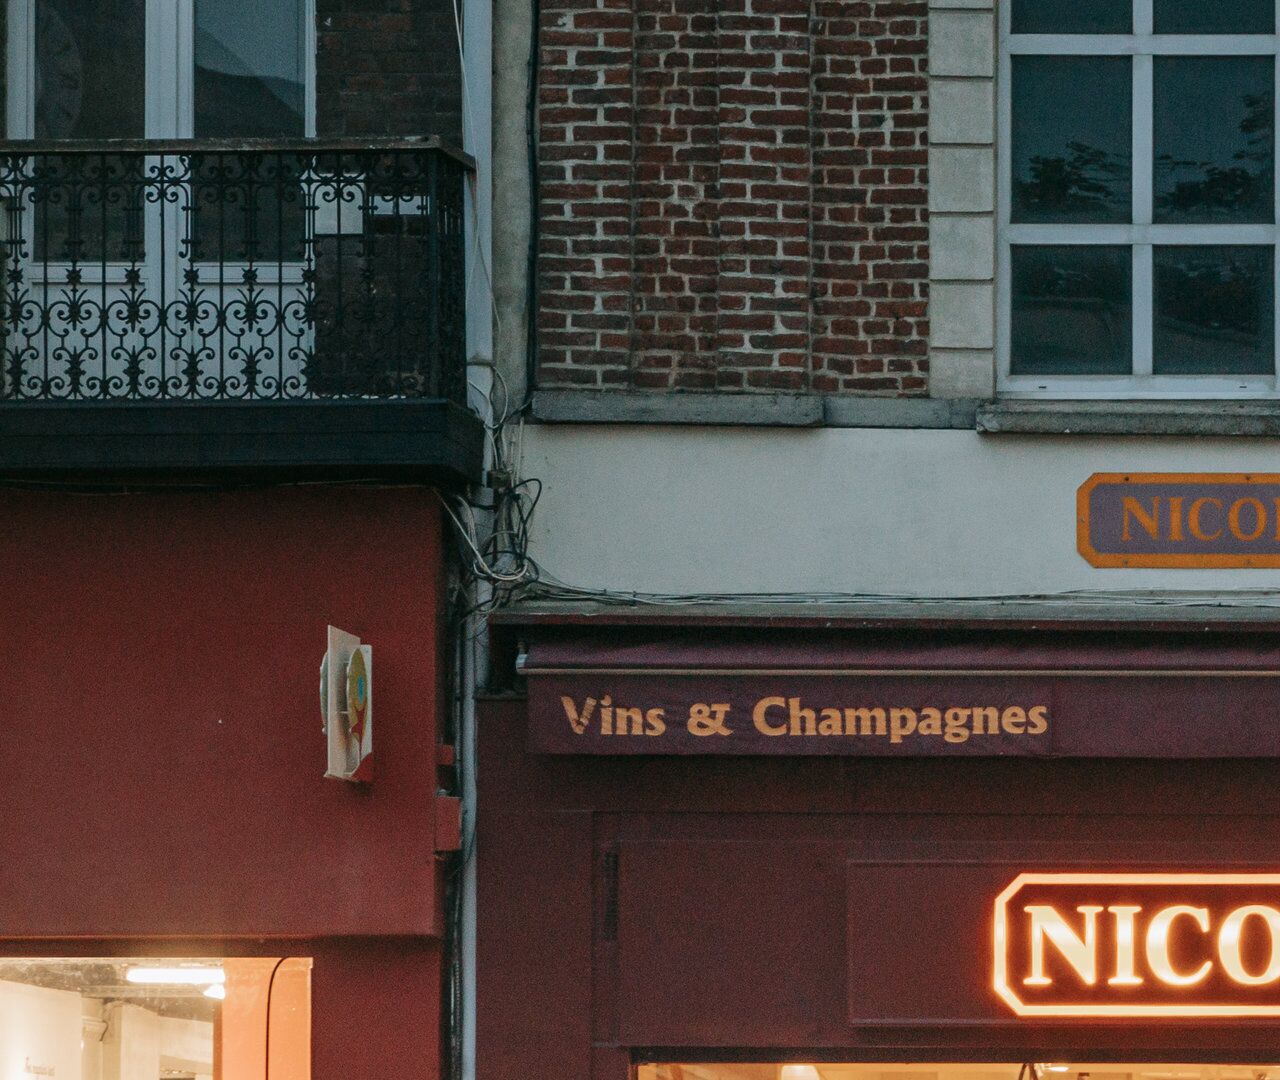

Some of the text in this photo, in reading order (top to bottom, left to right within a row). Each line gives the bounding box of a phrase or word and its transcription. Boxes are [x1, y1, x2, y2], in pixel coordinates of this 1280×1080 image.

[560, 695, 1049, 744] Vins & Champagnes
